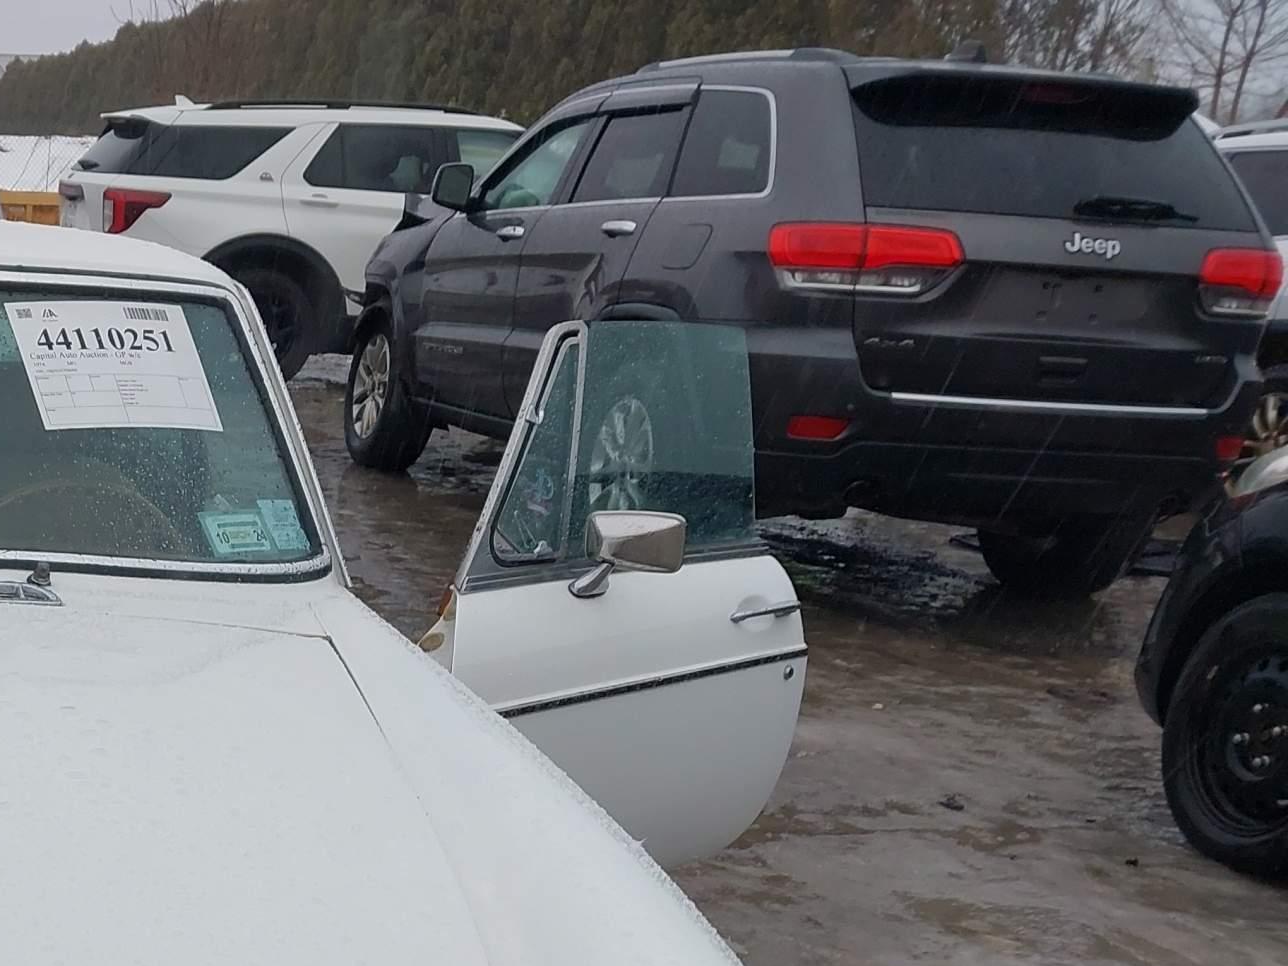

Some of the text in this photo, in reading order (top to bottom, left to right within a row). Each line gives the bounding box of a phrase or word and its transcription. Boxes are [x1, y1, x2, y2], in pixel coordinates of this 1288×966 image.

[1064, 232, 1121, 259] Jeep
[36, 327, 177, 353] 44110251
[29, 351, 57, 361] Capital
[59, 351, 78, 359] Auto
[79, 351, 109, 359] Auction
[114, 351, 126, 359] GP
[216, 530, 231, 546] 10
